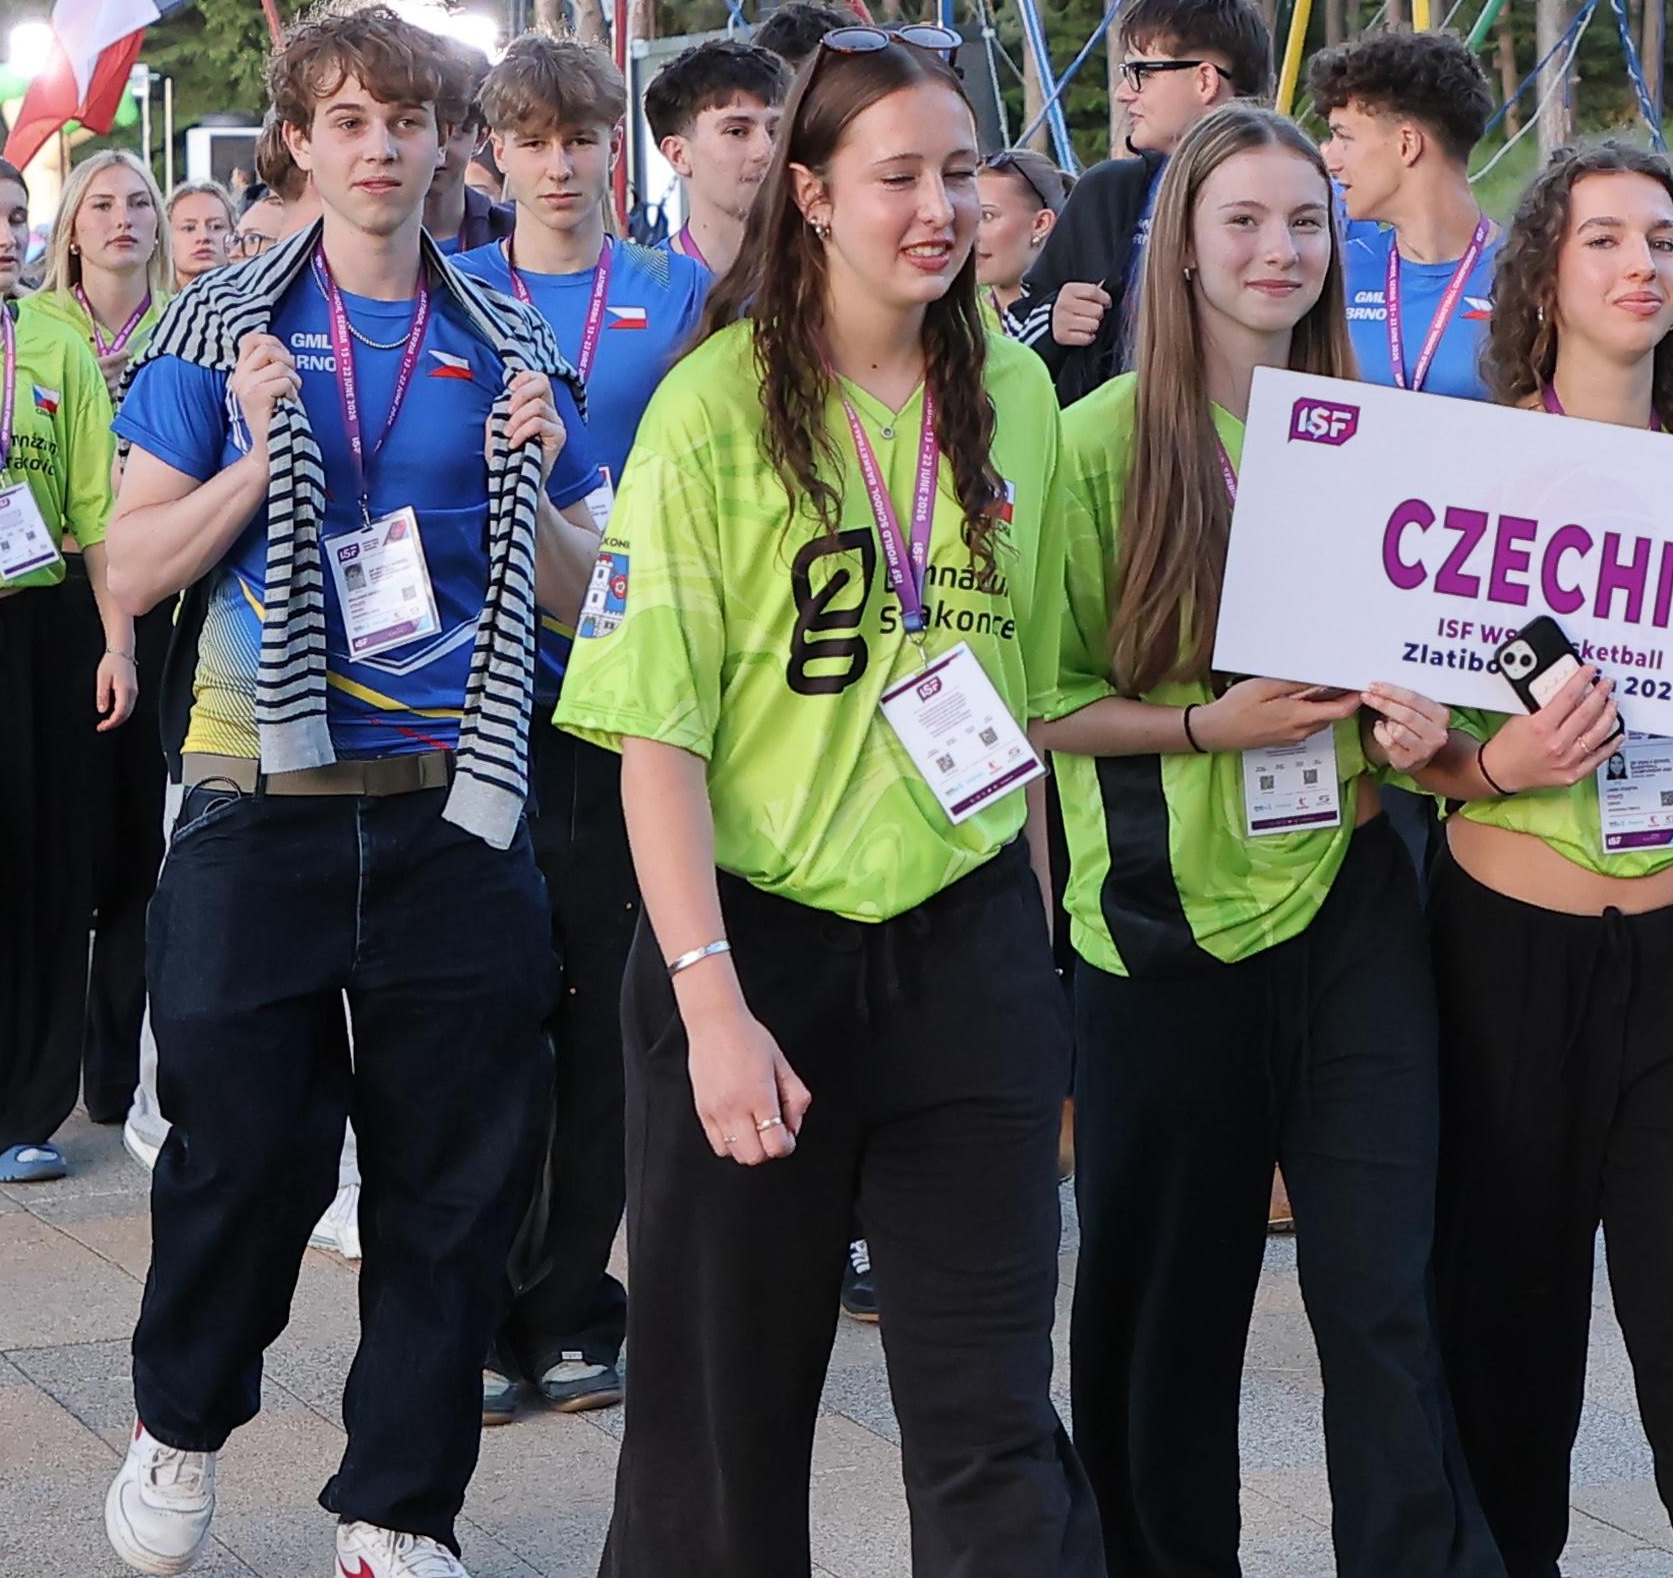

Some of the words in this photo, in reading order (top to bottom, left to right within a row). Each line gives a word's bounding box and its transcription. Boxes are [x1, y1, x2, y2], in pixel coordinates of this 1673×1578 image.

[1354, 291, 1385, 304] GML
[291, 333, 333, 349] GML
[296, 355, 337, 372] RNO
[343, 376, 354, 397] JUNE
[346, 399, 358, 420] 2026
[1297, 405, 1352, 438] ISF
[924, 430, 933, 442] 13
[853, 422, 877, 486] BASKETBALL
[922, 453, 931, 466] 22
[919, 467, 930, 493] JUNE
[871, 486, 890, 529] SCHOOL
[916, 495, 927, 521] 2026
[340, 545, 358, 560] ISF
[882, 530, 899, 566] WORLD
[911, 542, 923, 566] ISF
[891, 568, 904, 584] ISF
[1437, 617, 1475, 641] ISF
[1481, 624, 1520, 646] WS
[1571, 638, 1664, 671] sketball
[1402, 641, 1502, 675] Zlatibo
[919, 678, 940, 699] ISF
